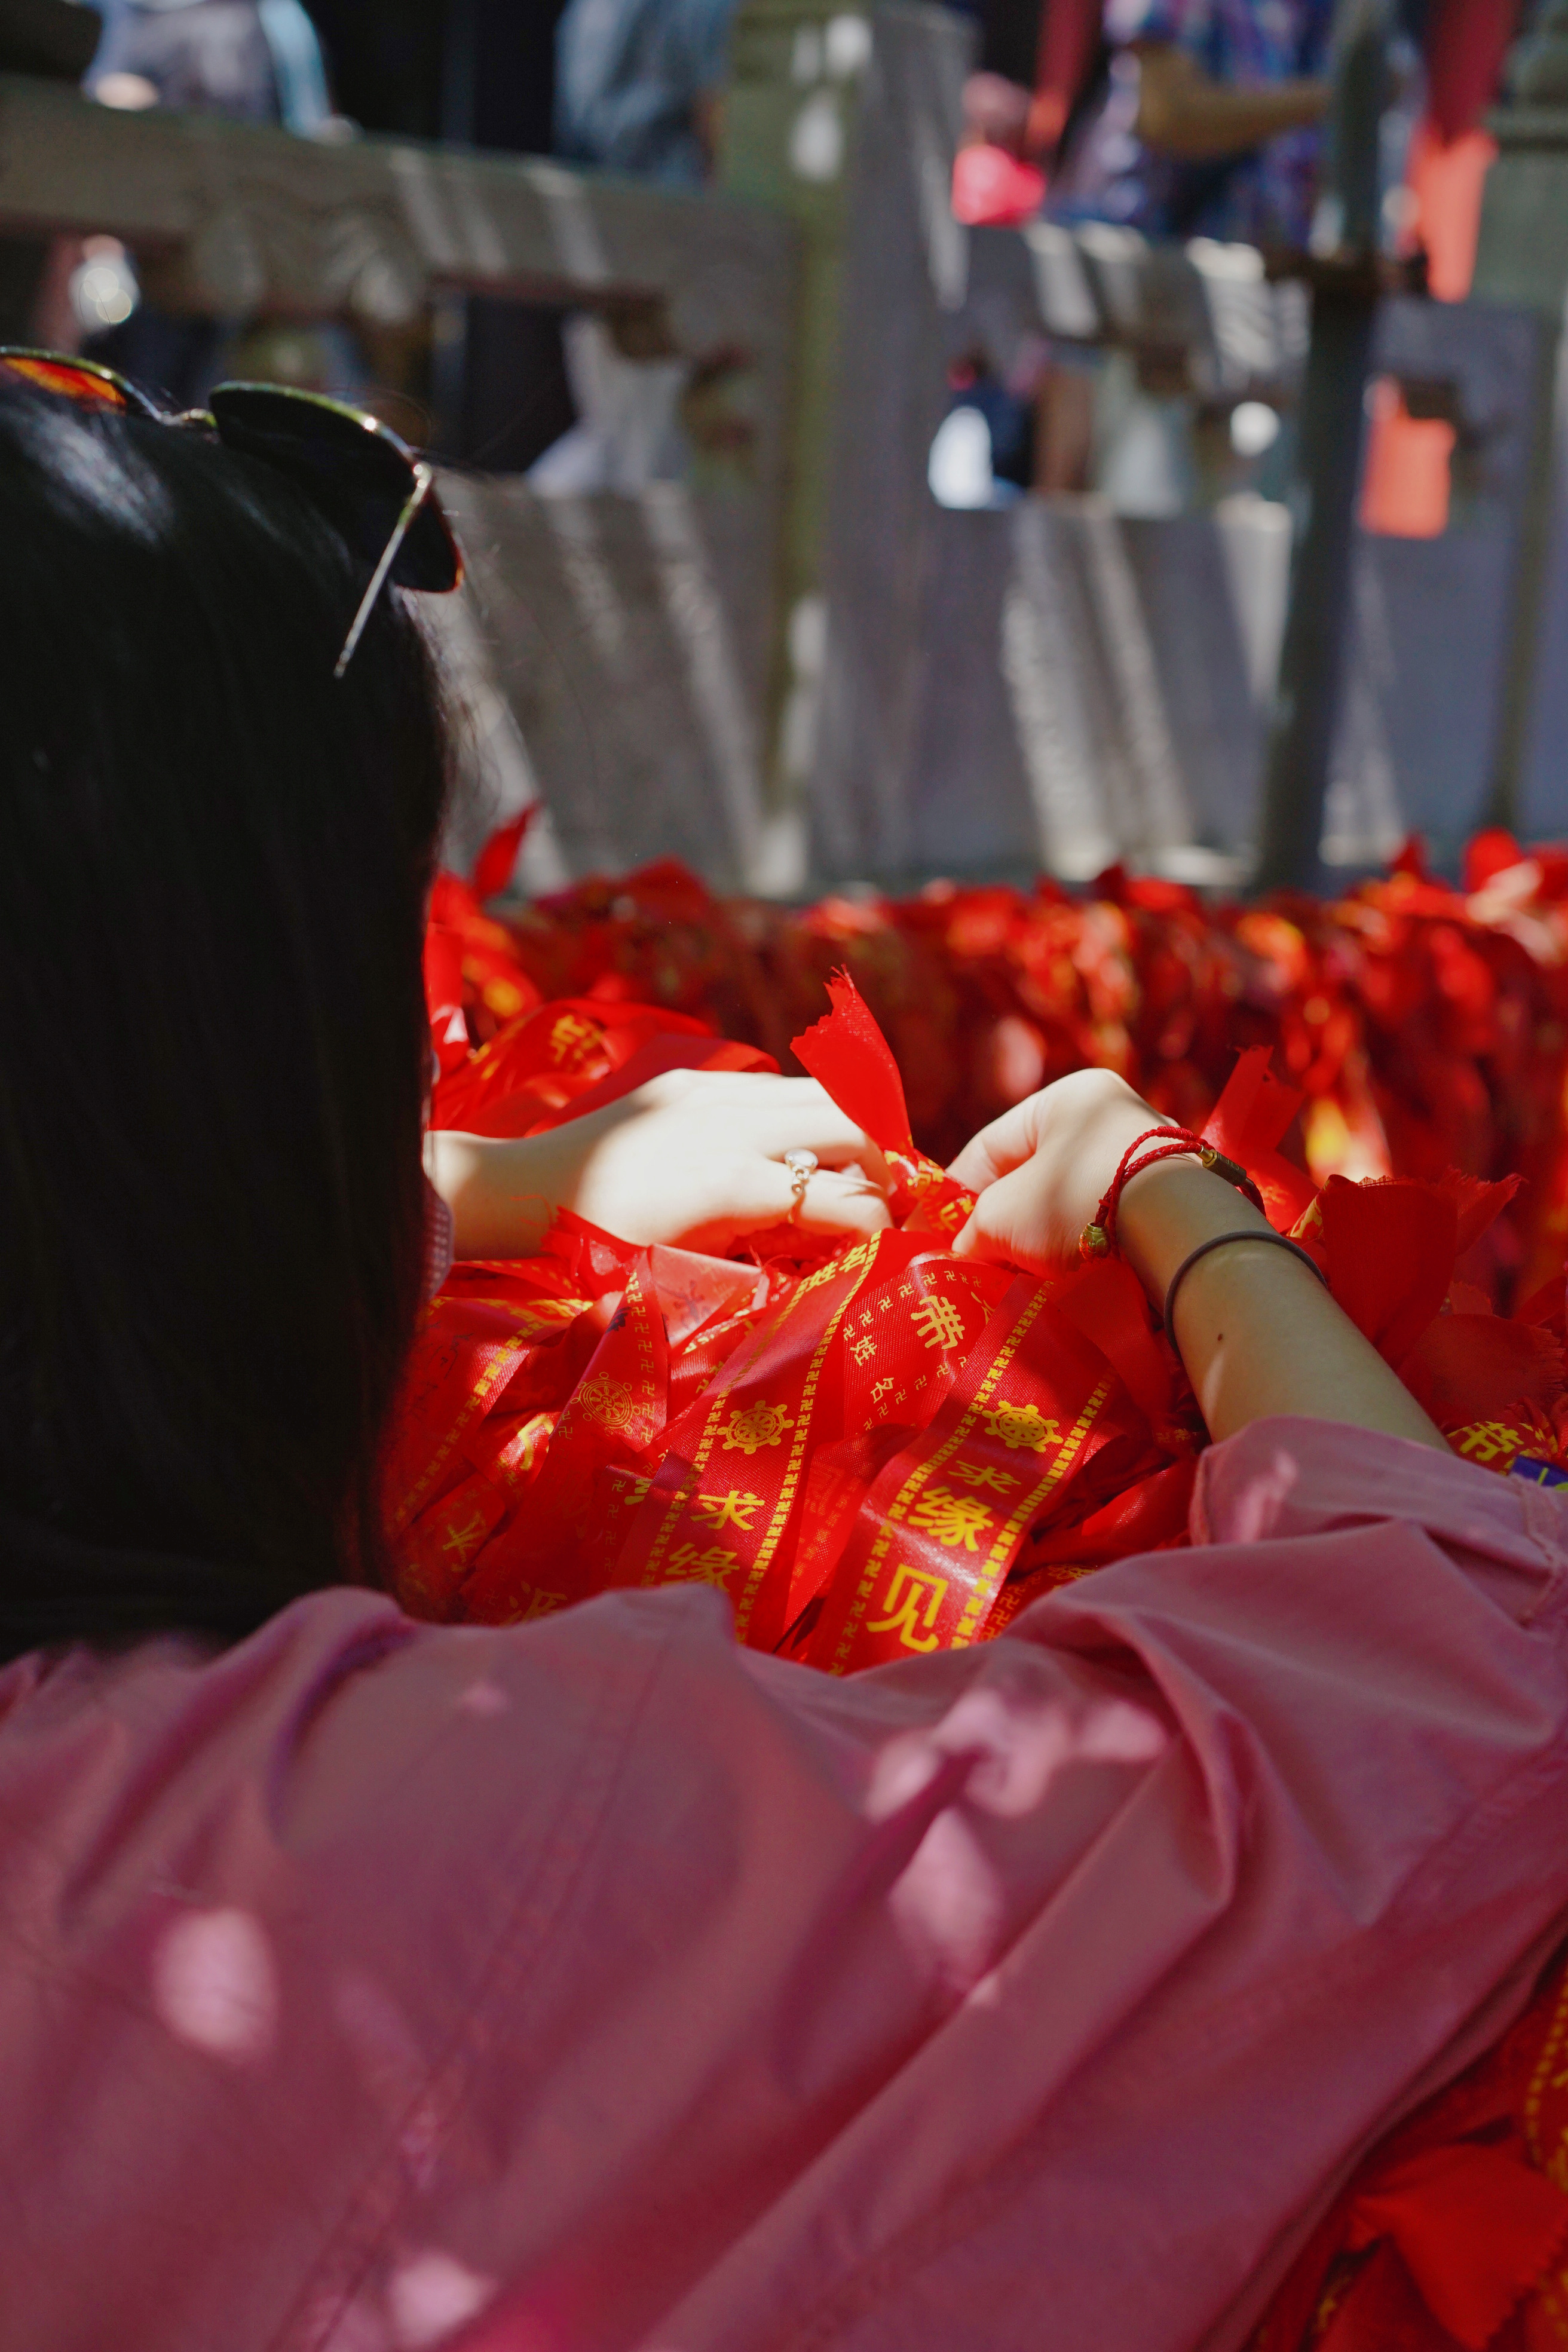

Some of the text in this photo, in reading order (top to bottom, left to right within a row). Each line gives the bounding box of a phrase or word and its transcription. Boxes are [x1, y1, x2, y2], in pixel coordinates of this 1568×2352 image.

[806, 1243, 868, 1293] 姓名
[911, 1291, 996, 1349] 带
[850, 1334, 895, 1404] 姓名
[660, 1490, 765, 1592] 求缘
